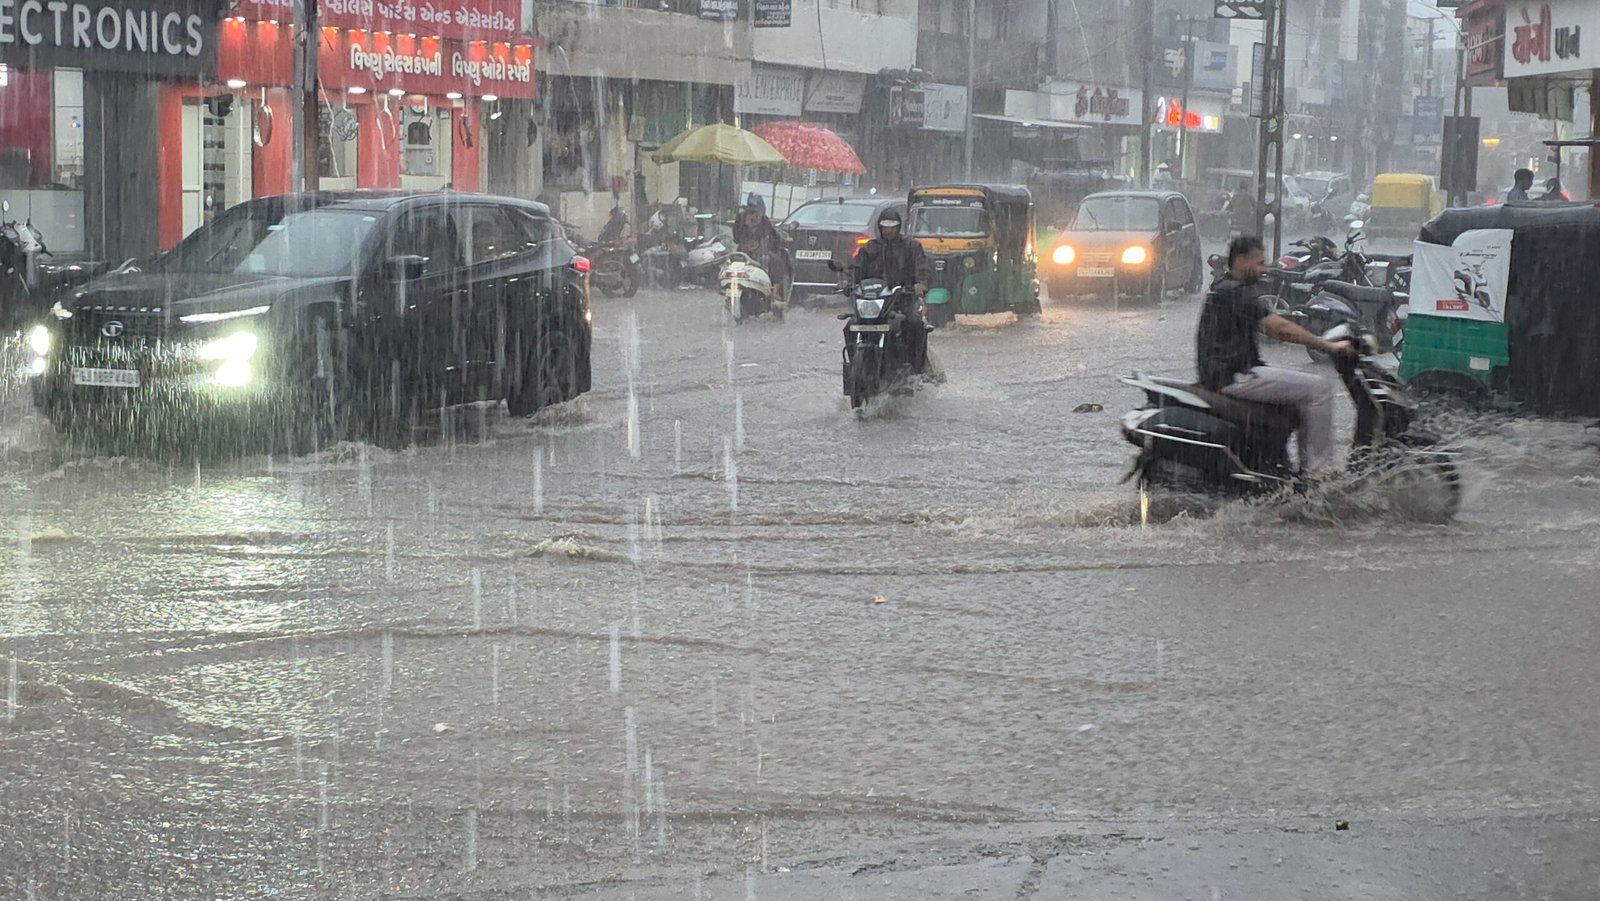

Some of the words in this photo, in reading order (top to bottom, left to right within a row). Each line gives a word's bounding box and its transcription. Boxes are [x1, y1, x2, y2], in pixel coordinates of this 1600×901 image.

[0, 0, 203, 56] ECTRONICS
[419, 2, 452, 24] એન્ડ
[350, 43, 383, 80] વિષ્ણુ
[452, 51, 481, 86] વિષ્ણુ
